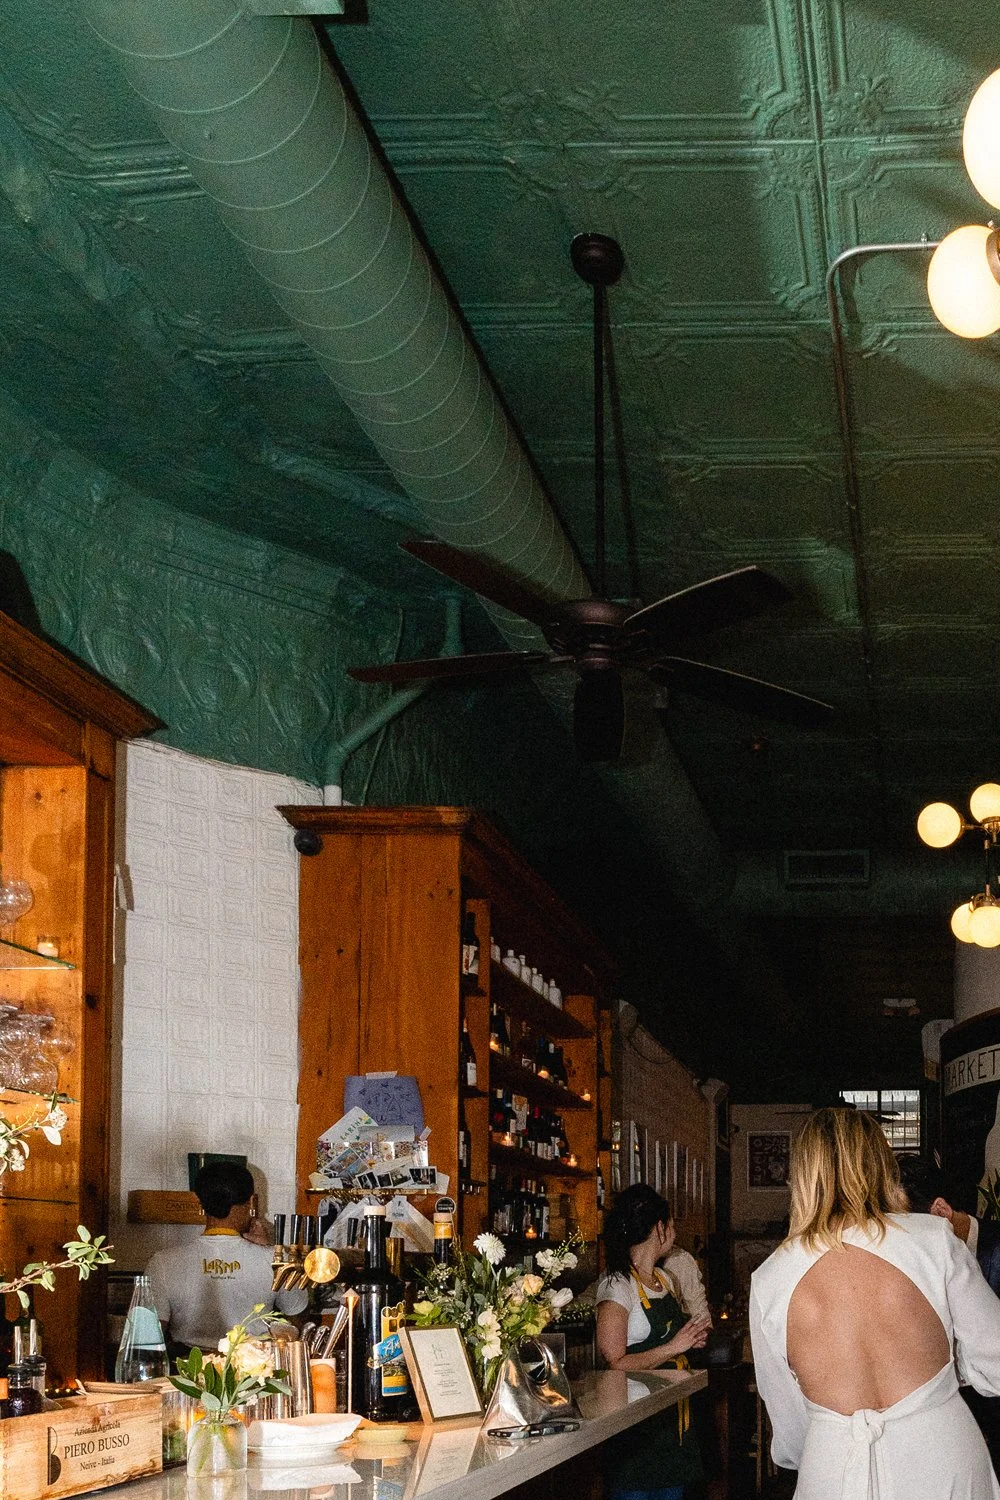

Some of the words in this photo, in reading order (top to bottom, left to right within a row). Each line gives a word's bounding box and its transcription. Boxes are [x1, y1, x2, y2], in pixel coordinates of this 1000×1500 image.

[64, 1440, 95, 1459] PIERO
[98, 1433, 130, 1452] BUSSO
[80, 1460, 97, 1471] Neive
[101, 1456, 116, 1468] Italia
